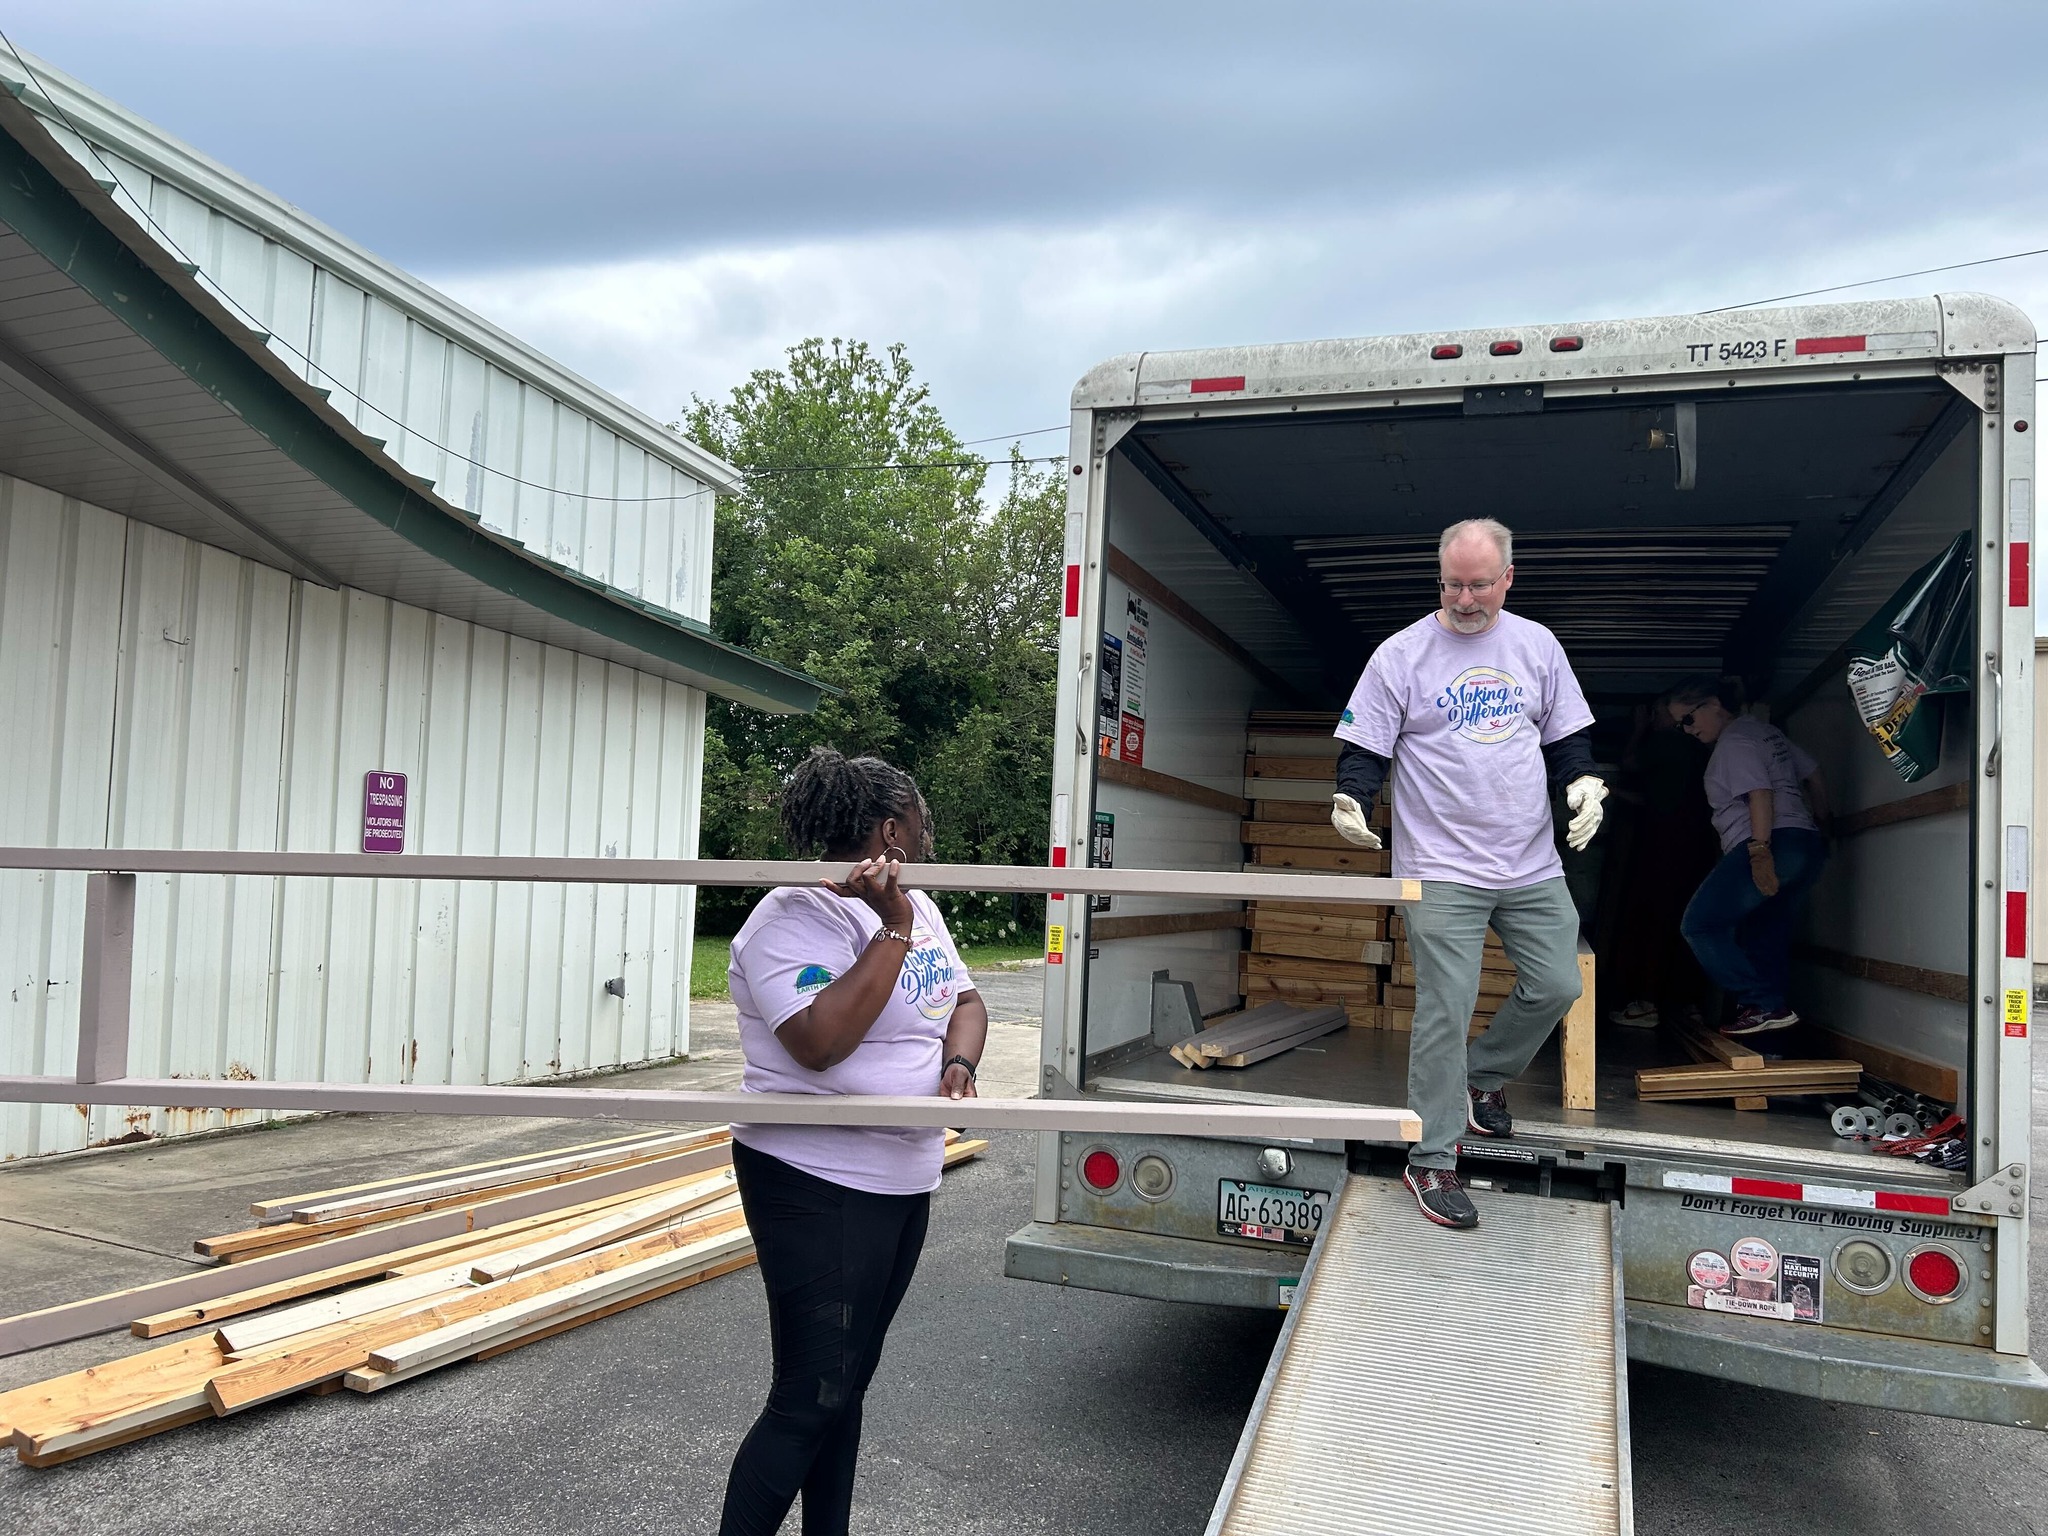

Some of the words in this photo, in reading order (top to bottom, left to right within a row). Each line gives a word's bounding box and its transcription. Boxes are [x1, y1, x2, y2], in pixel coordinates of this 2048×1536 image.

[1686, 343, 1714, 362] TT
[1719, 340, 1767, 361] 5423
[1774, 339, 1787, 357] F
[1884, 661, 1896, 669] BAG
[1437, 683, 1511, 708] Making
[1514, 686, 1523, 697] a
[1448, 701, 1524, 732] Differenc
[379, 776, 394, 790] NO
[369, 793, 402, 807] TRESPASSING
[366, 816, 391, 827] VIOLATORS
[392, 818, 403, 828] WILL
[365, 828, 372, 837] BE
[372, 828, 403, 839] PROSECUTED
[796, 983, 819, 995] EARTH
[901, 965, 955, 1005] Differen
[1247, 1185, 1303, 1198] ARIZONA
[1681, 1193, 1726, 1212] Don't
[1730, 1200, 1785, 1219] Forget
[1789, 1206, 1827, 1223] Your
[1831, 1211, 1894, 1234] Moving
[1784, 1264, 1819, 1274] MAXIMUM
[1784, 1270, 1819, 1280] SECURITY
[1725, 1299, 1758, 1310] TIE-DOWN
[1759, 1303, 1777, 1312] ROPE
